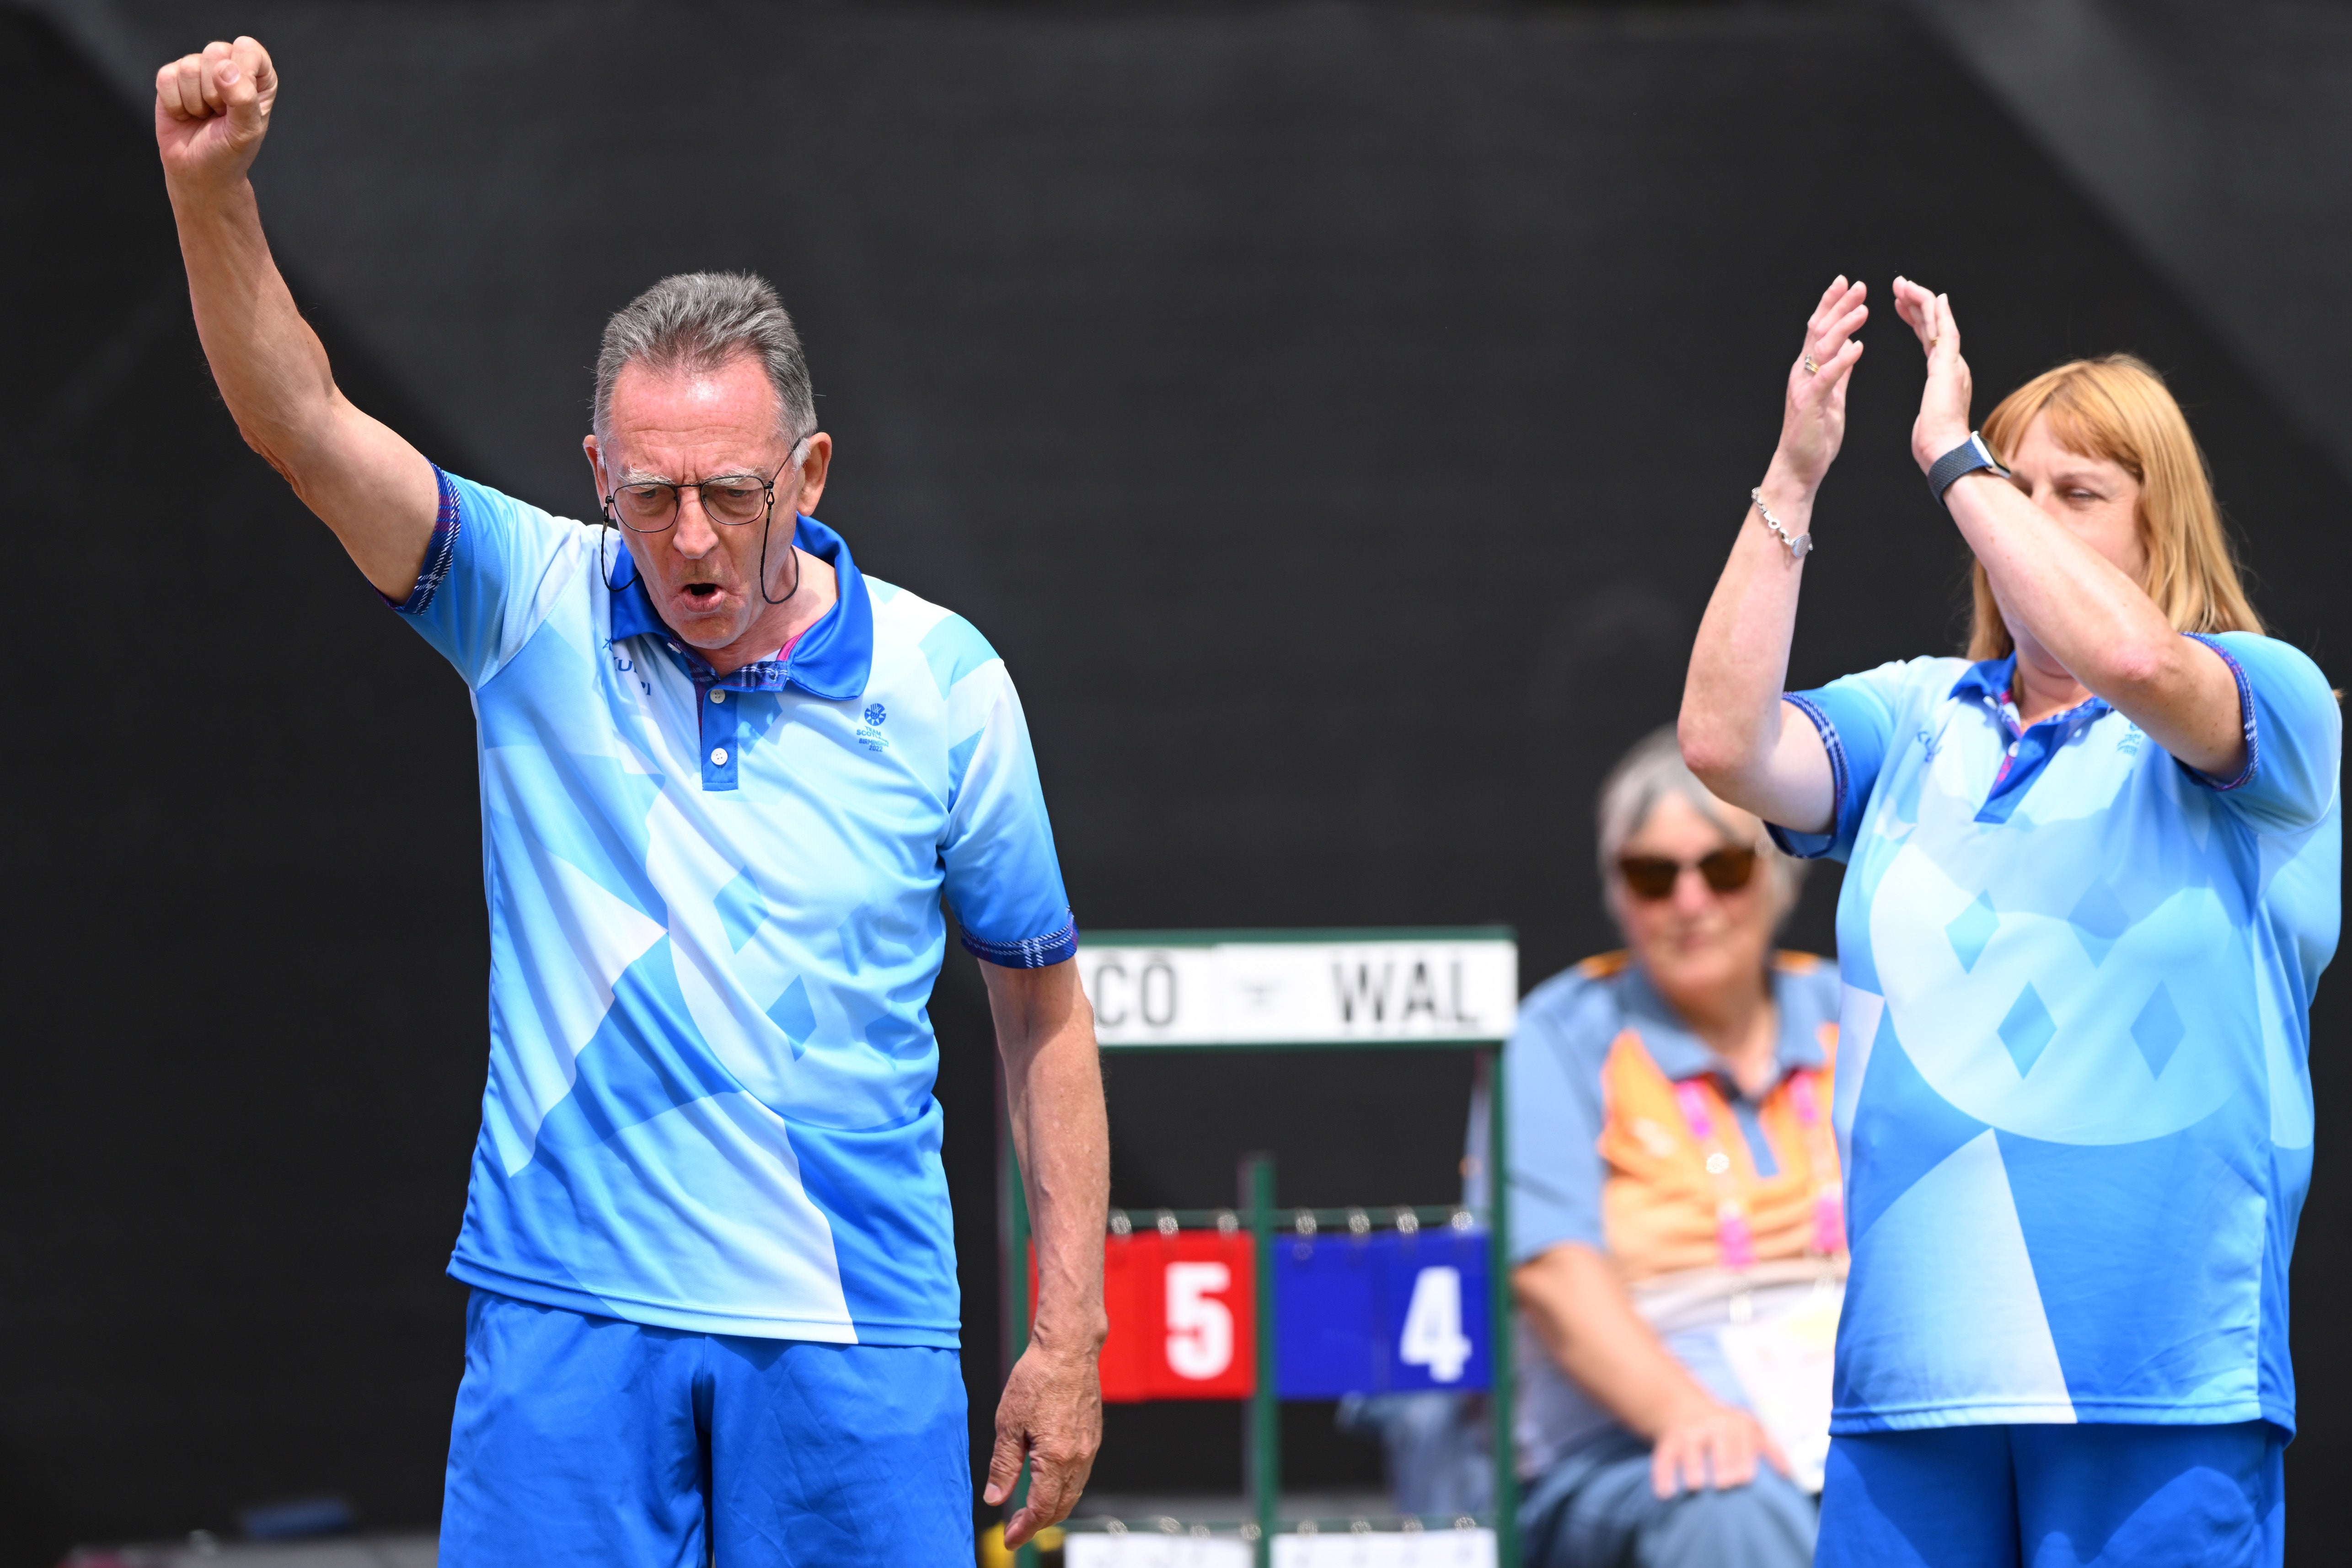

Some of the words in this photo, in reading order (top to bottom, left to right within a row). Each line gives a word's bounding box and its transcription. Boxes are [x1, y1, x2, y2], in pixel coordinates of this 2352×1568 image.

[857, 729, 889, 743] SCOTL
[865, 726, 881, 736] TEAM
[1331, 961, 1479, 1024] WAL
[1164, 1261, 1234, 1381] 5
[1400, 1265, 1473, 1383] 4
